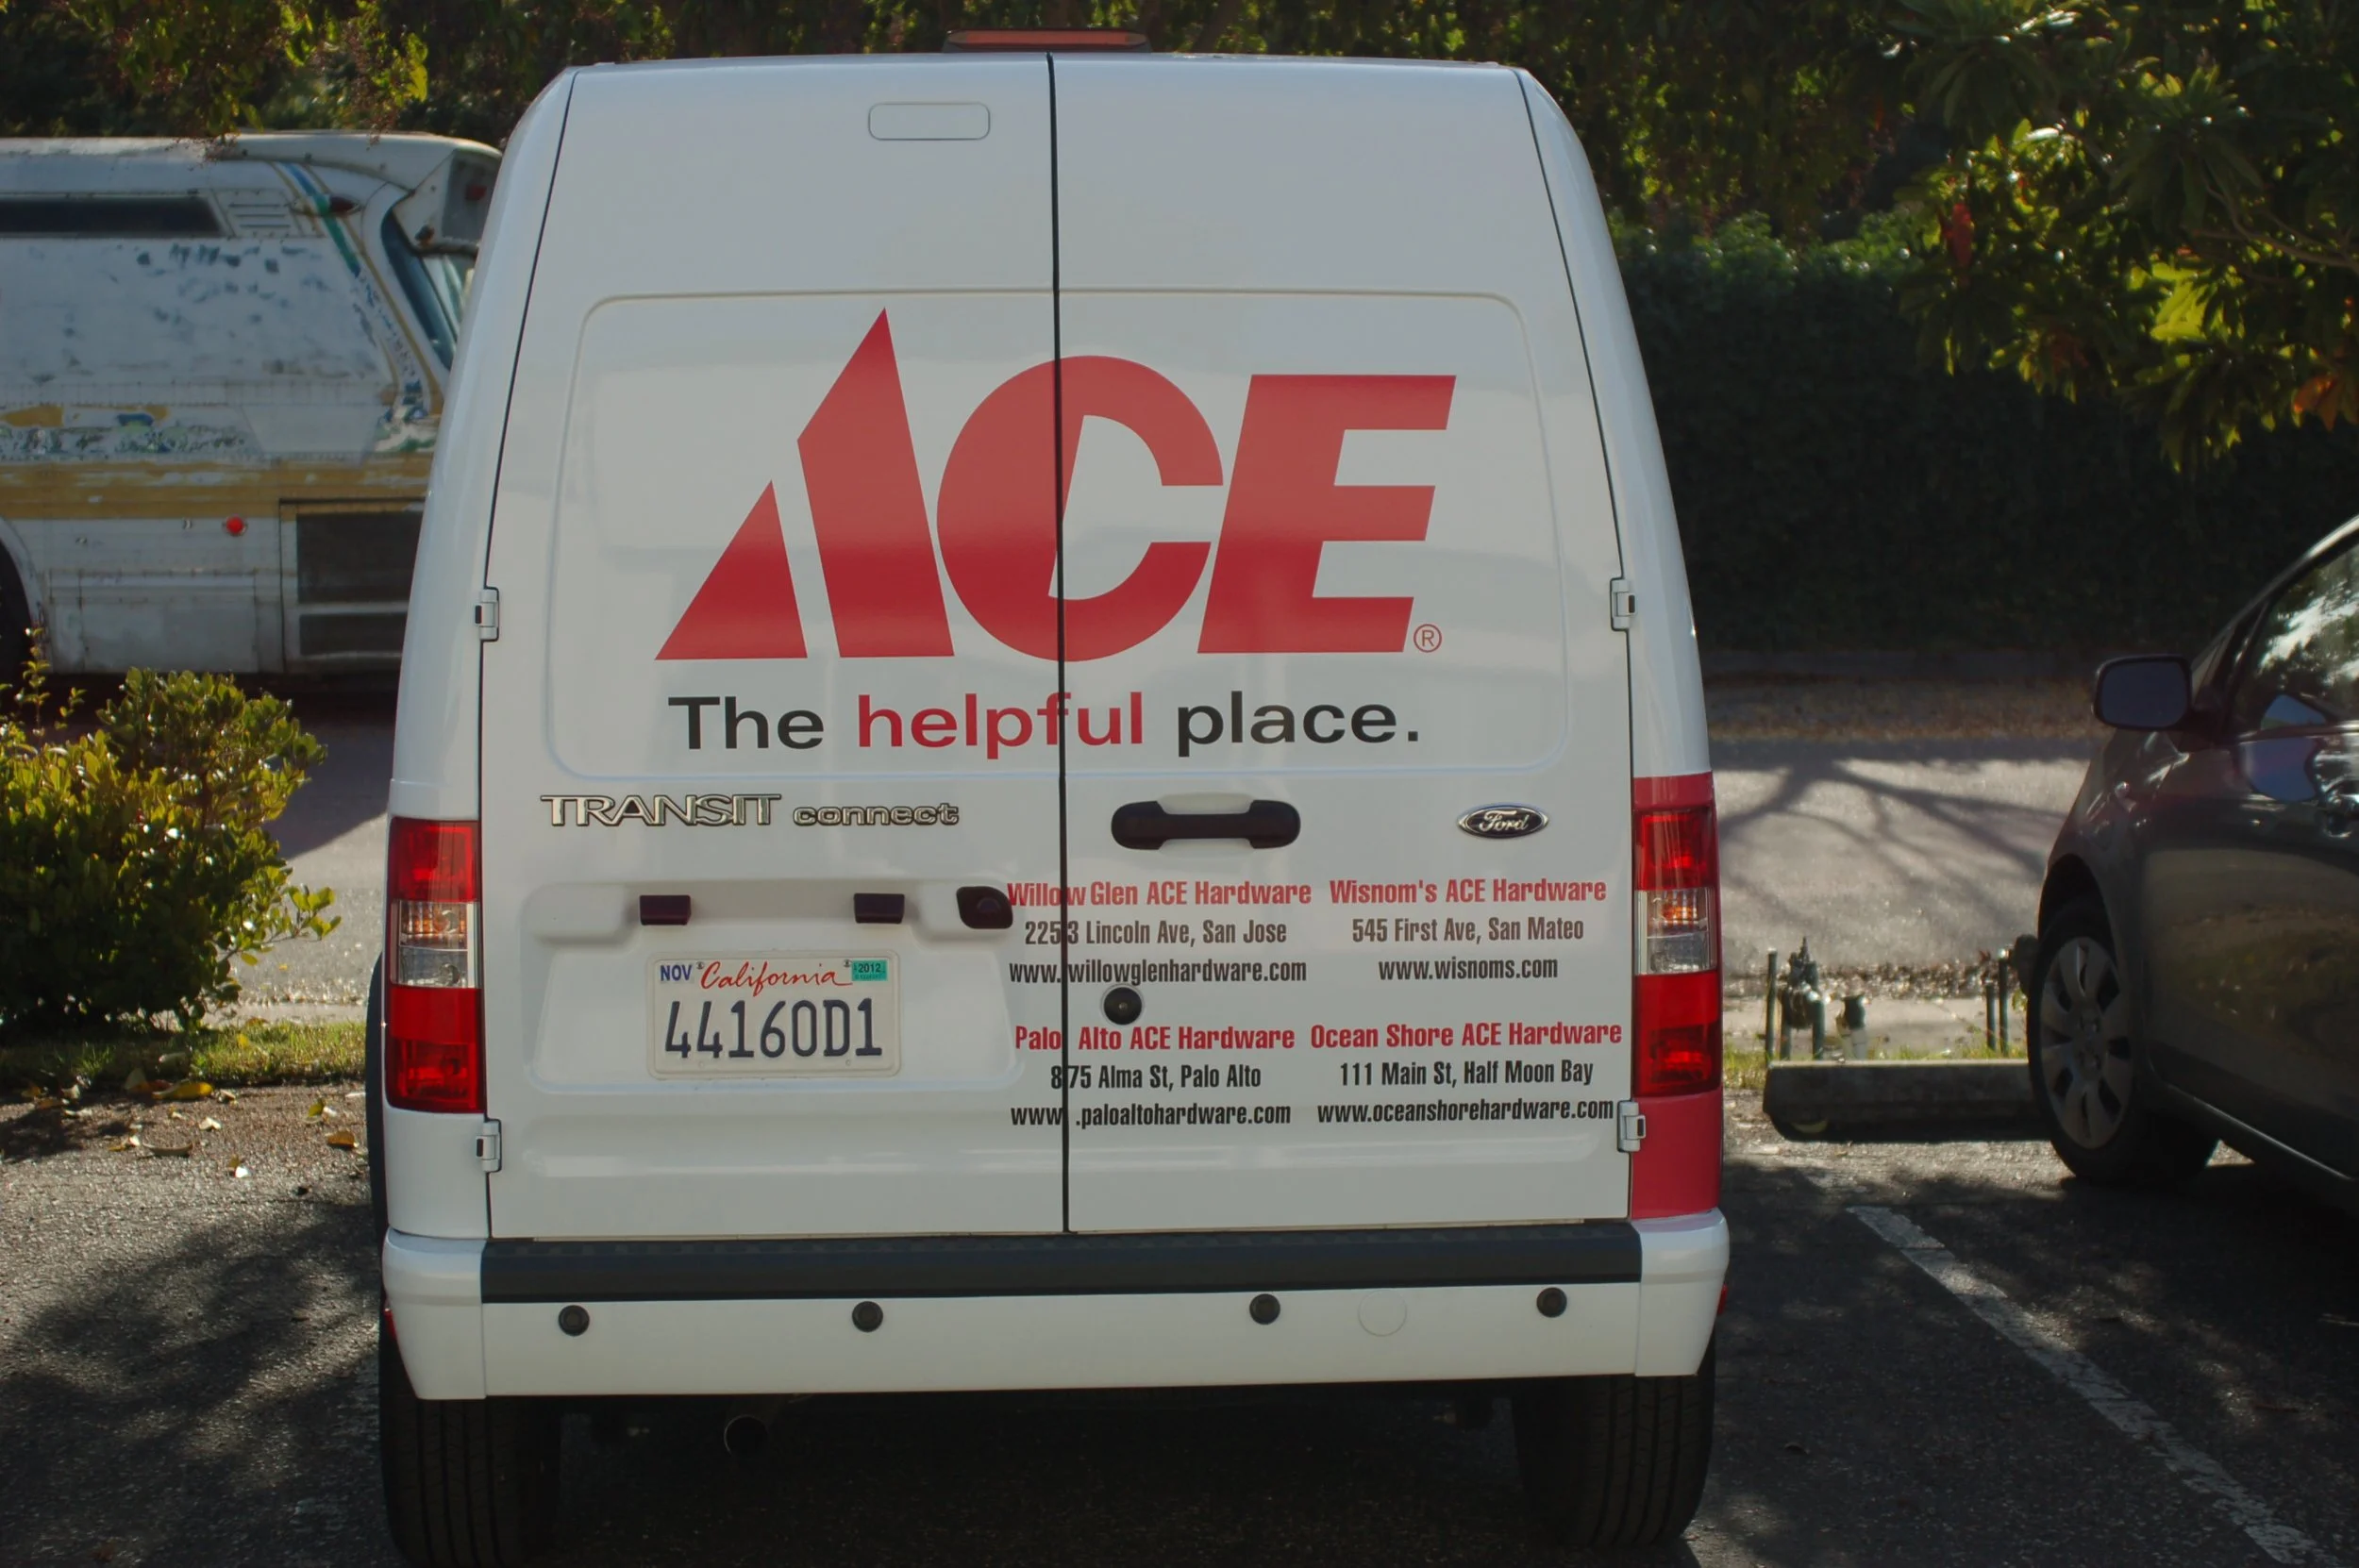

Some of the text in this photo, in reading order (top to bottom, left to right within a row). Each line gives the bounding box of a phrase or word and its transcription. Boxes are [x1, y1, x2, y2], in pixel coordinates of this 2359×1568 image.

[655, 308, 1456, 662] ACE
[668, 691, 1418, 759] The helpful place.
[540, 793, 960, 826] TRANSIT connect
[1479, 809, 1530, 832] Ford
[1007, 880, 1312, 907] Willow Glen ACE Hardware
[1330, 878, 1606, 904] Wisnom's ACE Hardware
[1025, 920, 1286, 946] 2253 Lincoln Ave, San Jose
[1352, 917, 1583, 943] 545 First Ave, San Mateo
[661, 964, 692, 981] NOV
[700, 961, 852, 996] California
[859, 962, 881, 973] 2012
[1010, 959, 1307, 986] www.willowglenhardware.com
[1379, 957, 1558, 980] www.wisnoms.com
[665, 998, 882, 1059] 44160D1
[1015, 1026, 1295, 1050] Palo Alto ACE Hardware
[1311, 1022, 1622, 1048] Ocean Shore ACE Hardware
[1050, 1064, 1261, 1092] 875 Alma St, Palo Alto
[1341, 1059, 1593, 1087] 111 Main St, Half Moon Bay
[1318, 1098, 1614, 1123] www.oceanshorehardware.com
